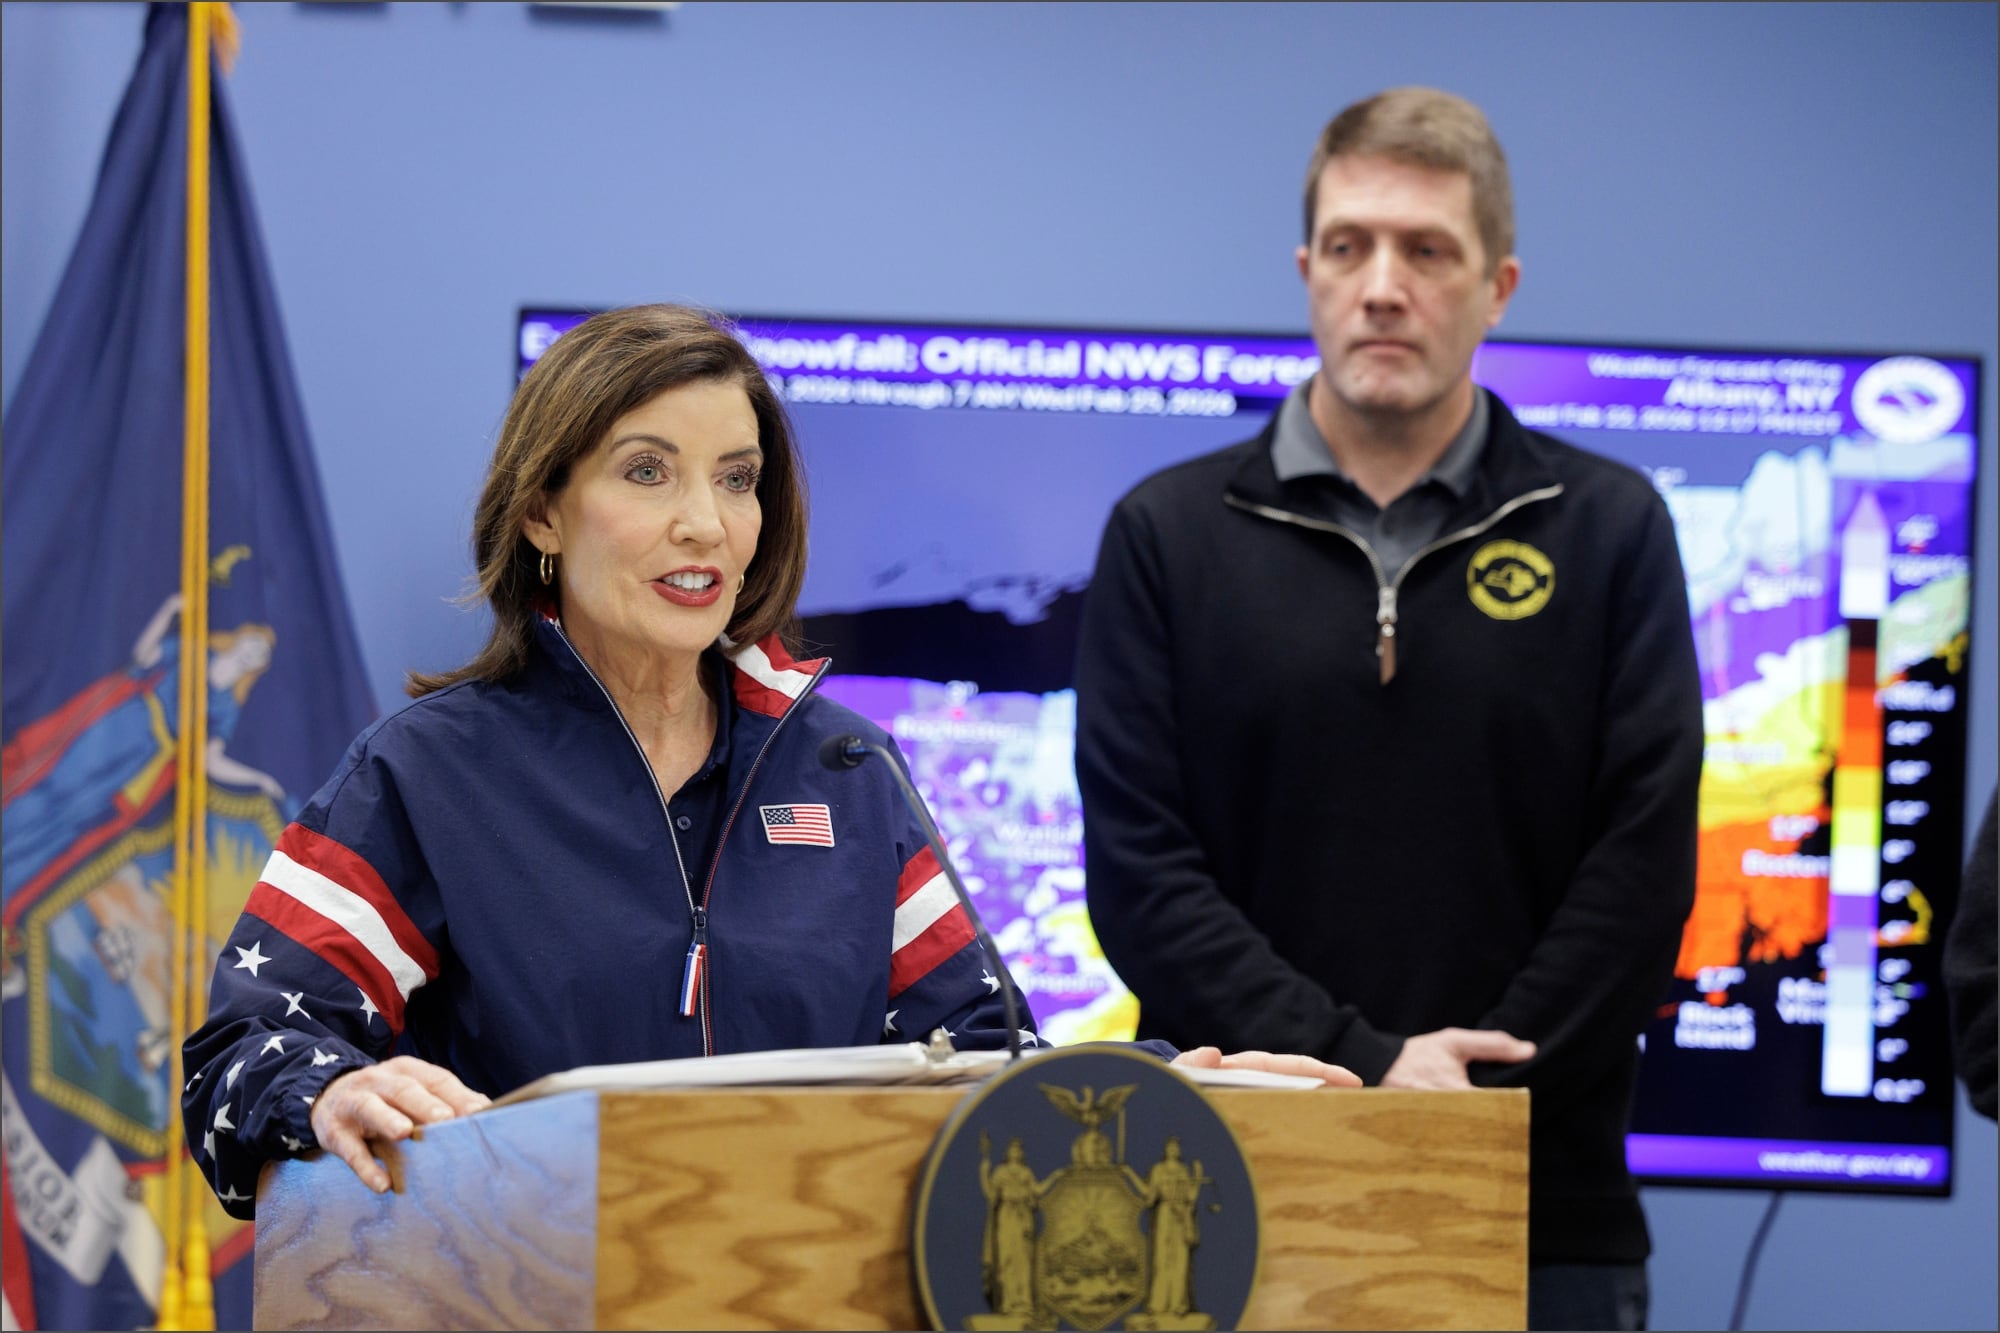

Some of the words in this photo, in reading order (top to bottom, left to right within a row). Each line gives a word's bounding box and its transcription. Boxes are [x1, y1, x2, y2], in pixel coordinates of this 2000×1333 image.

[740, 331, 918, 373] nowfall:
[921, 336, 1081, 378] Official
[1085, 341, 1201, 382] NWS
[1588, 354, 1676, 379] Weather
[1678, 357, 1772, 382] Forecast
[1775, 359, 1845, 384] Office
[789, 374, 851, 403] 2026
[853, 377, 951, 409] through
[954, 379, 971, 407] 7
[973, 381, 1019, 408] AM
[1021, 382, 1078, 411] Wed
[1080, 384, 1127, 413] Feb
[1129, 386, 1165, 415] 25,
[1168, 388, 1237, 416] 2026
[1664, 378, 1784, 411] Albany,
[1787, 382, 1841, 410] NY
[1561, 404, 1602, 427] Feb
[1759, 1151, 1931, 1178] weather.gov/aly
